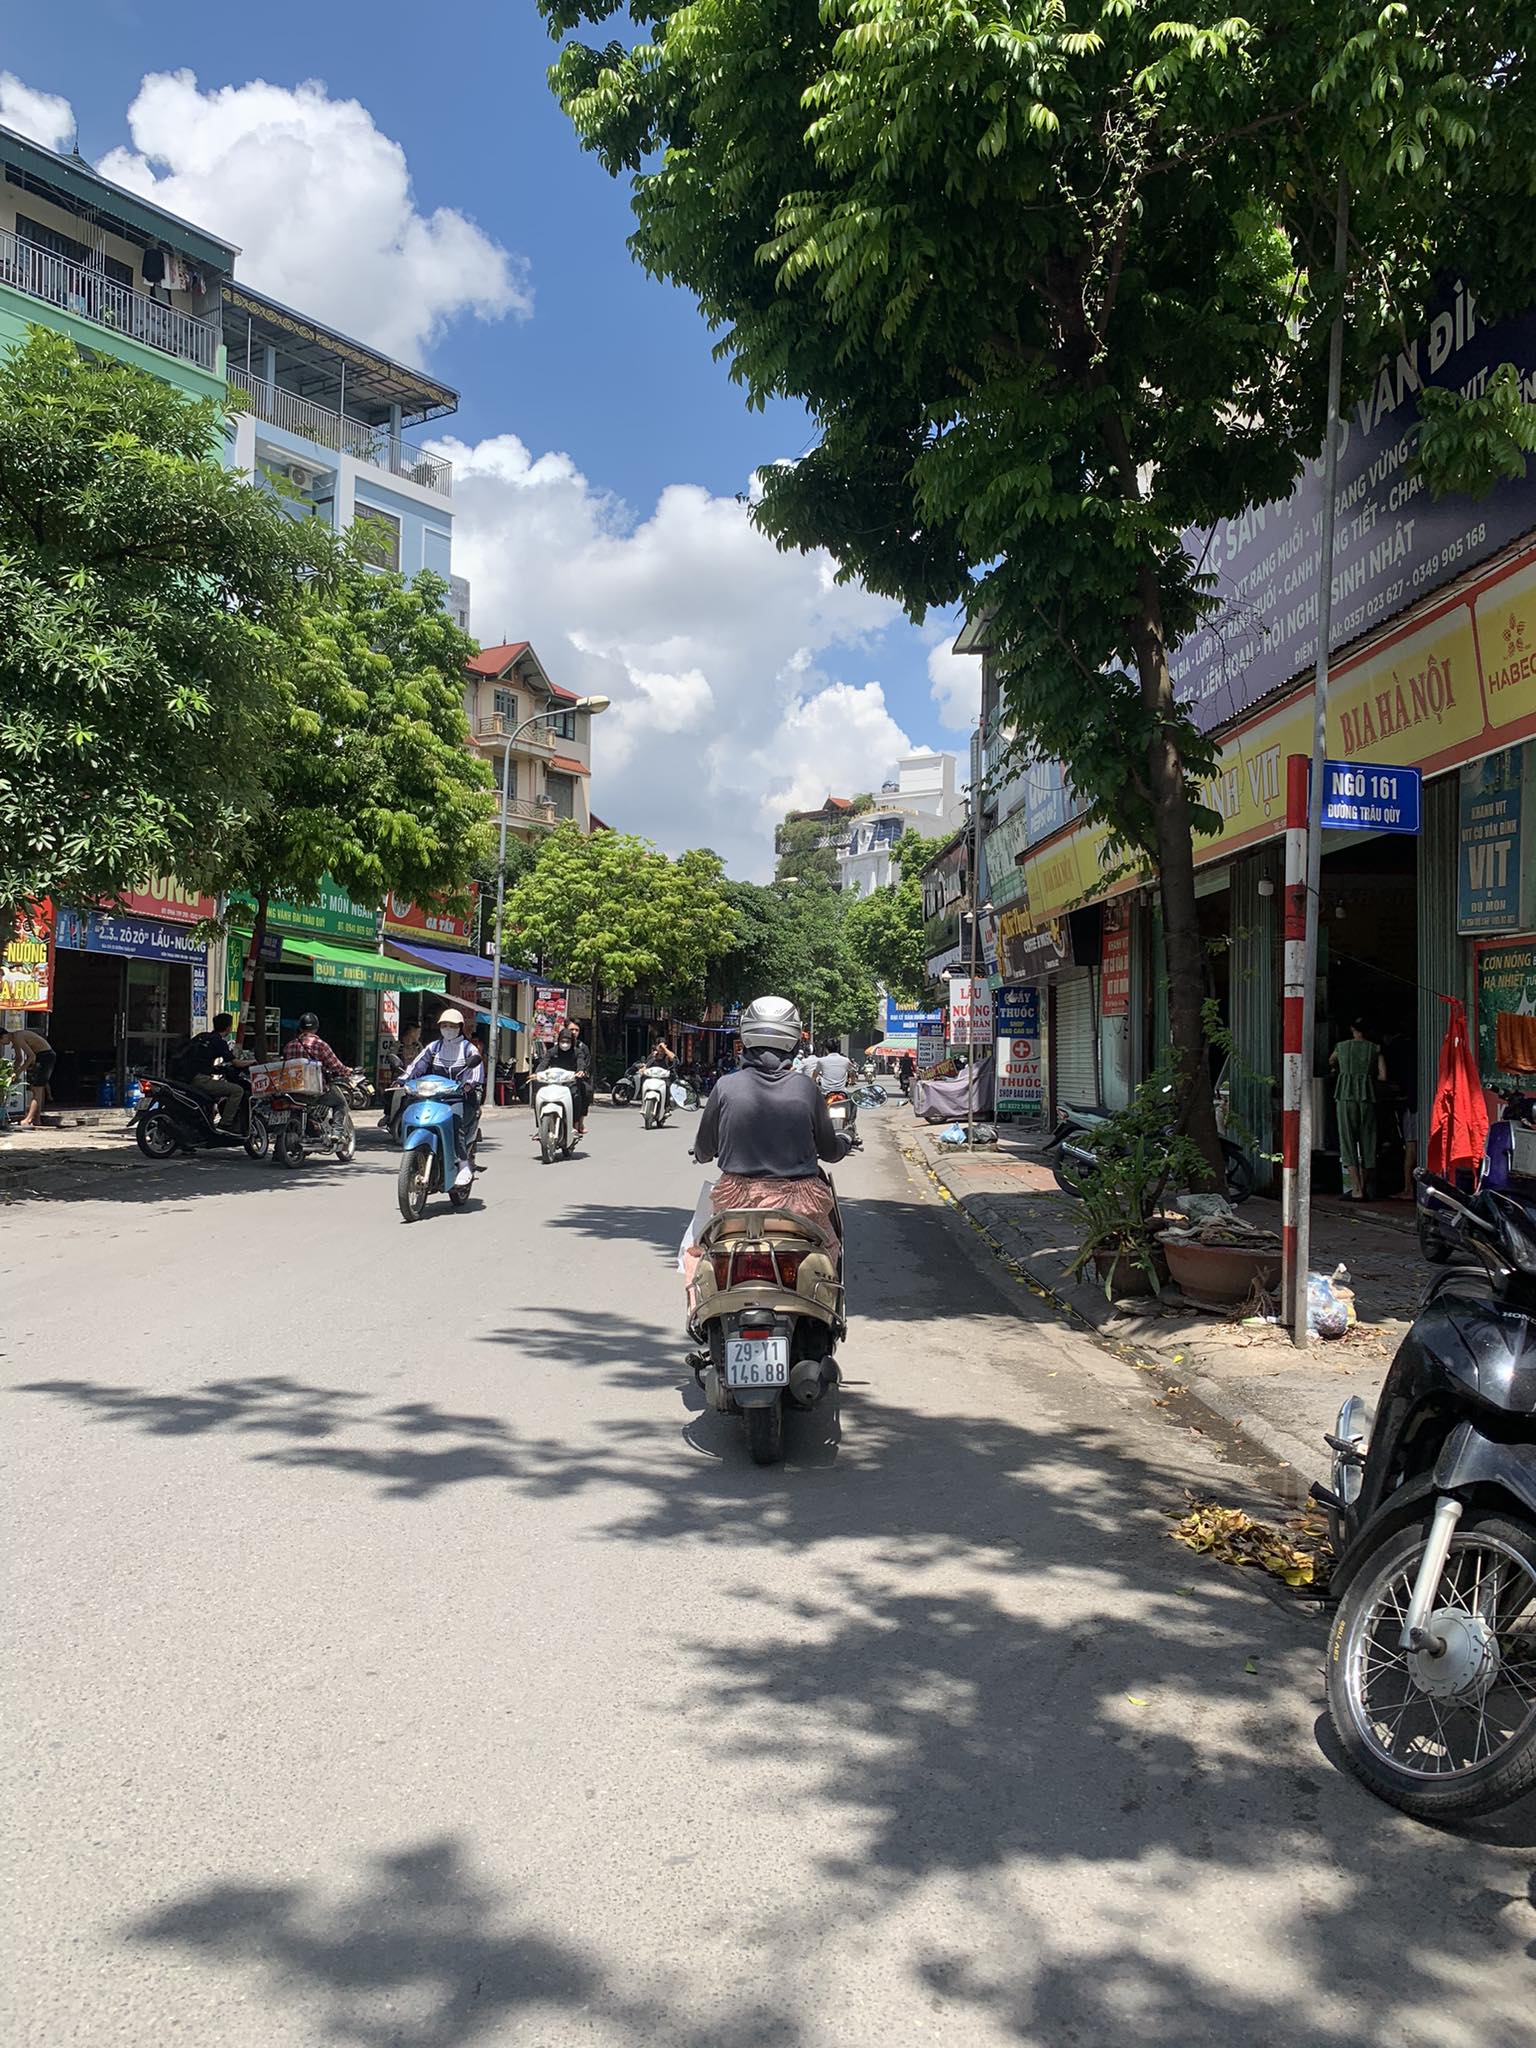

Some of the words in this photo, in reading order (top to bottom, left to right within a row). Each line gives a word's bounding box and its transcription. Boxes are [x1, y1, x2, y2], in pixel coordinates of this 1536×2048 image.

[1330, 557, 1366, 607] SINH
[1370, 519, 1416, 579] NHẬT
[1283, 555, 1314, 596] CANH
[1344, 605, 1366, 632] 0357
[1367, 590, 1385, 617] 023
[1386, 577, 1404, 606] 627
[1412, 556, 1439, 588] 0349
[1441, 538, 1464, 568] 905
[1466, 522, 1487, 552] 168
[1339, 701, 1378, 757] BIA
[1374, 671, 1412, 739] HÀ
[1408, 652, 1457, 726] NỘI
[1246, 742, 1281, 817] VỊT
[1332, 769, 1366, 798] NGÕ
[1370, 775, 1398, 800] 161
[1327, 800, 1359, 820] ĐƯỜNG
[1359, 804, 1382, 822] TRÂU
[329, 893, 349, 914] MÓN
[1503, 951, 1532, 969] NÓNG
[1000, 1005, 1035, 1018] THUỐC
[1000, 1074, 1041, 1088] THUỐC
[735, 1341, 778, 1363] 29-Y1
[731, 1363, 785, 1385] 146.88
